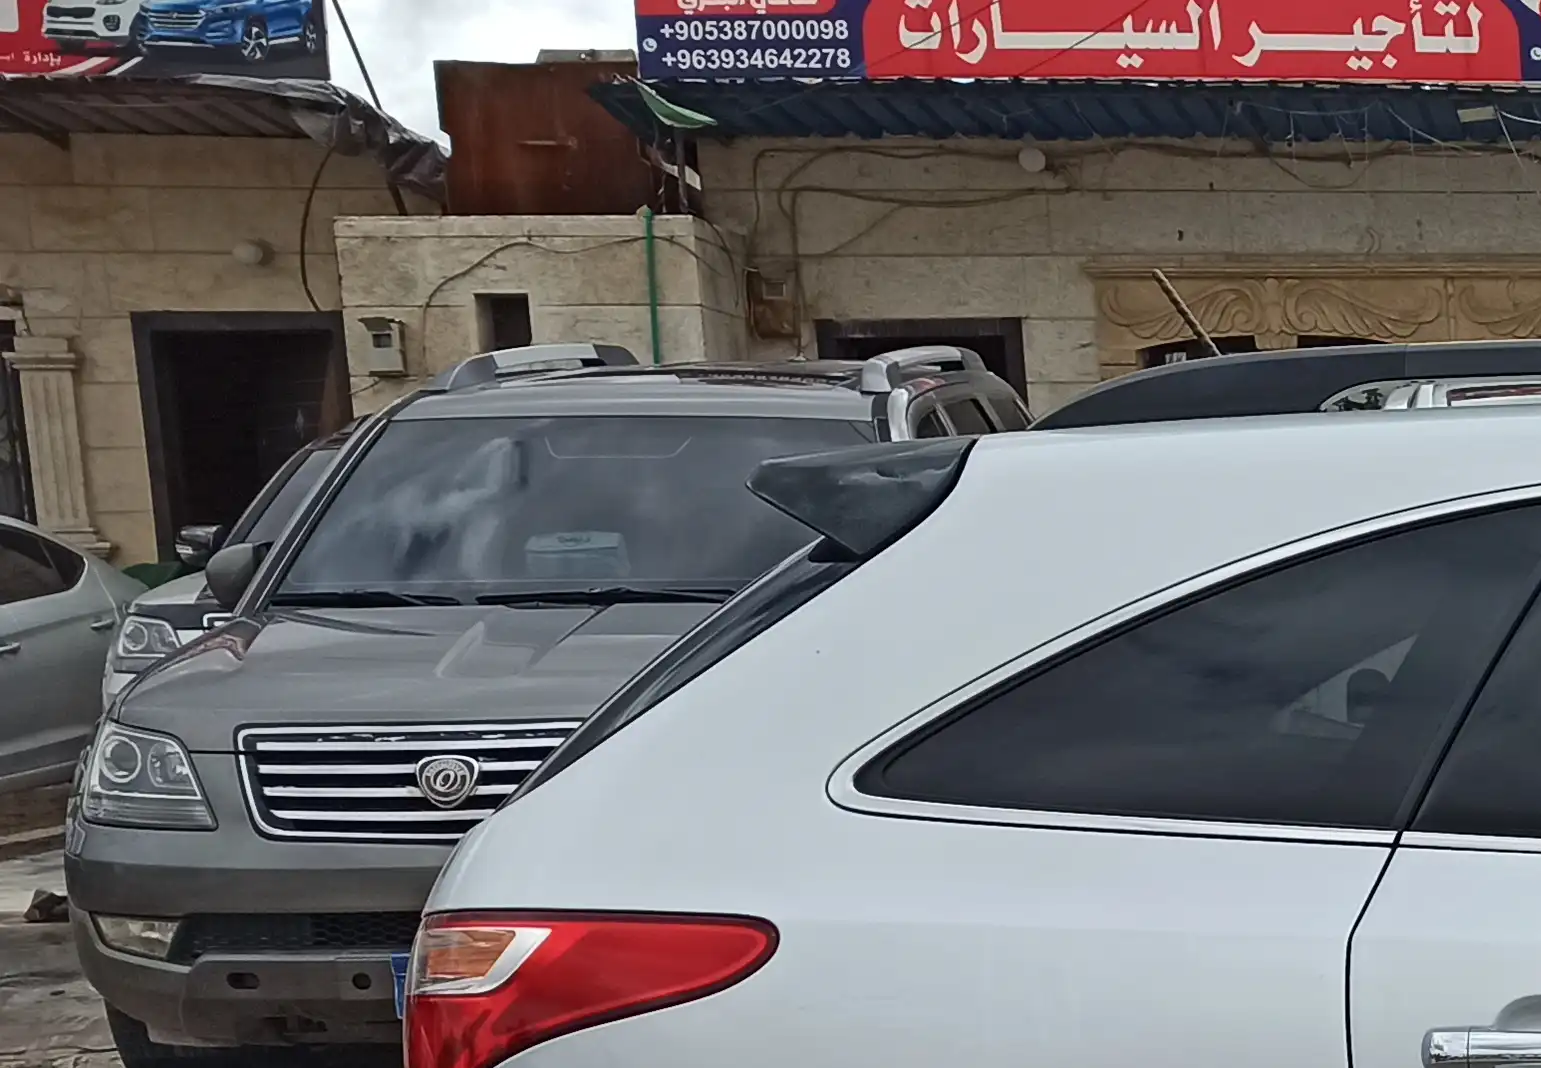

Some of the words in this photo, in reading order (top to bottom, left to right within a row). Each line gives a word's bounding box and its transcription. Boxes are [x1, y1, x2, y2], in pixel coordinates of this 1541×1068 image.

[660, 19, 849, 41] +905387000098
[899, 0, 1221, 69] السيارات
[1232, 0, 1483, 71] لتأجير
[662, 48, 851, 69] +963934642278
